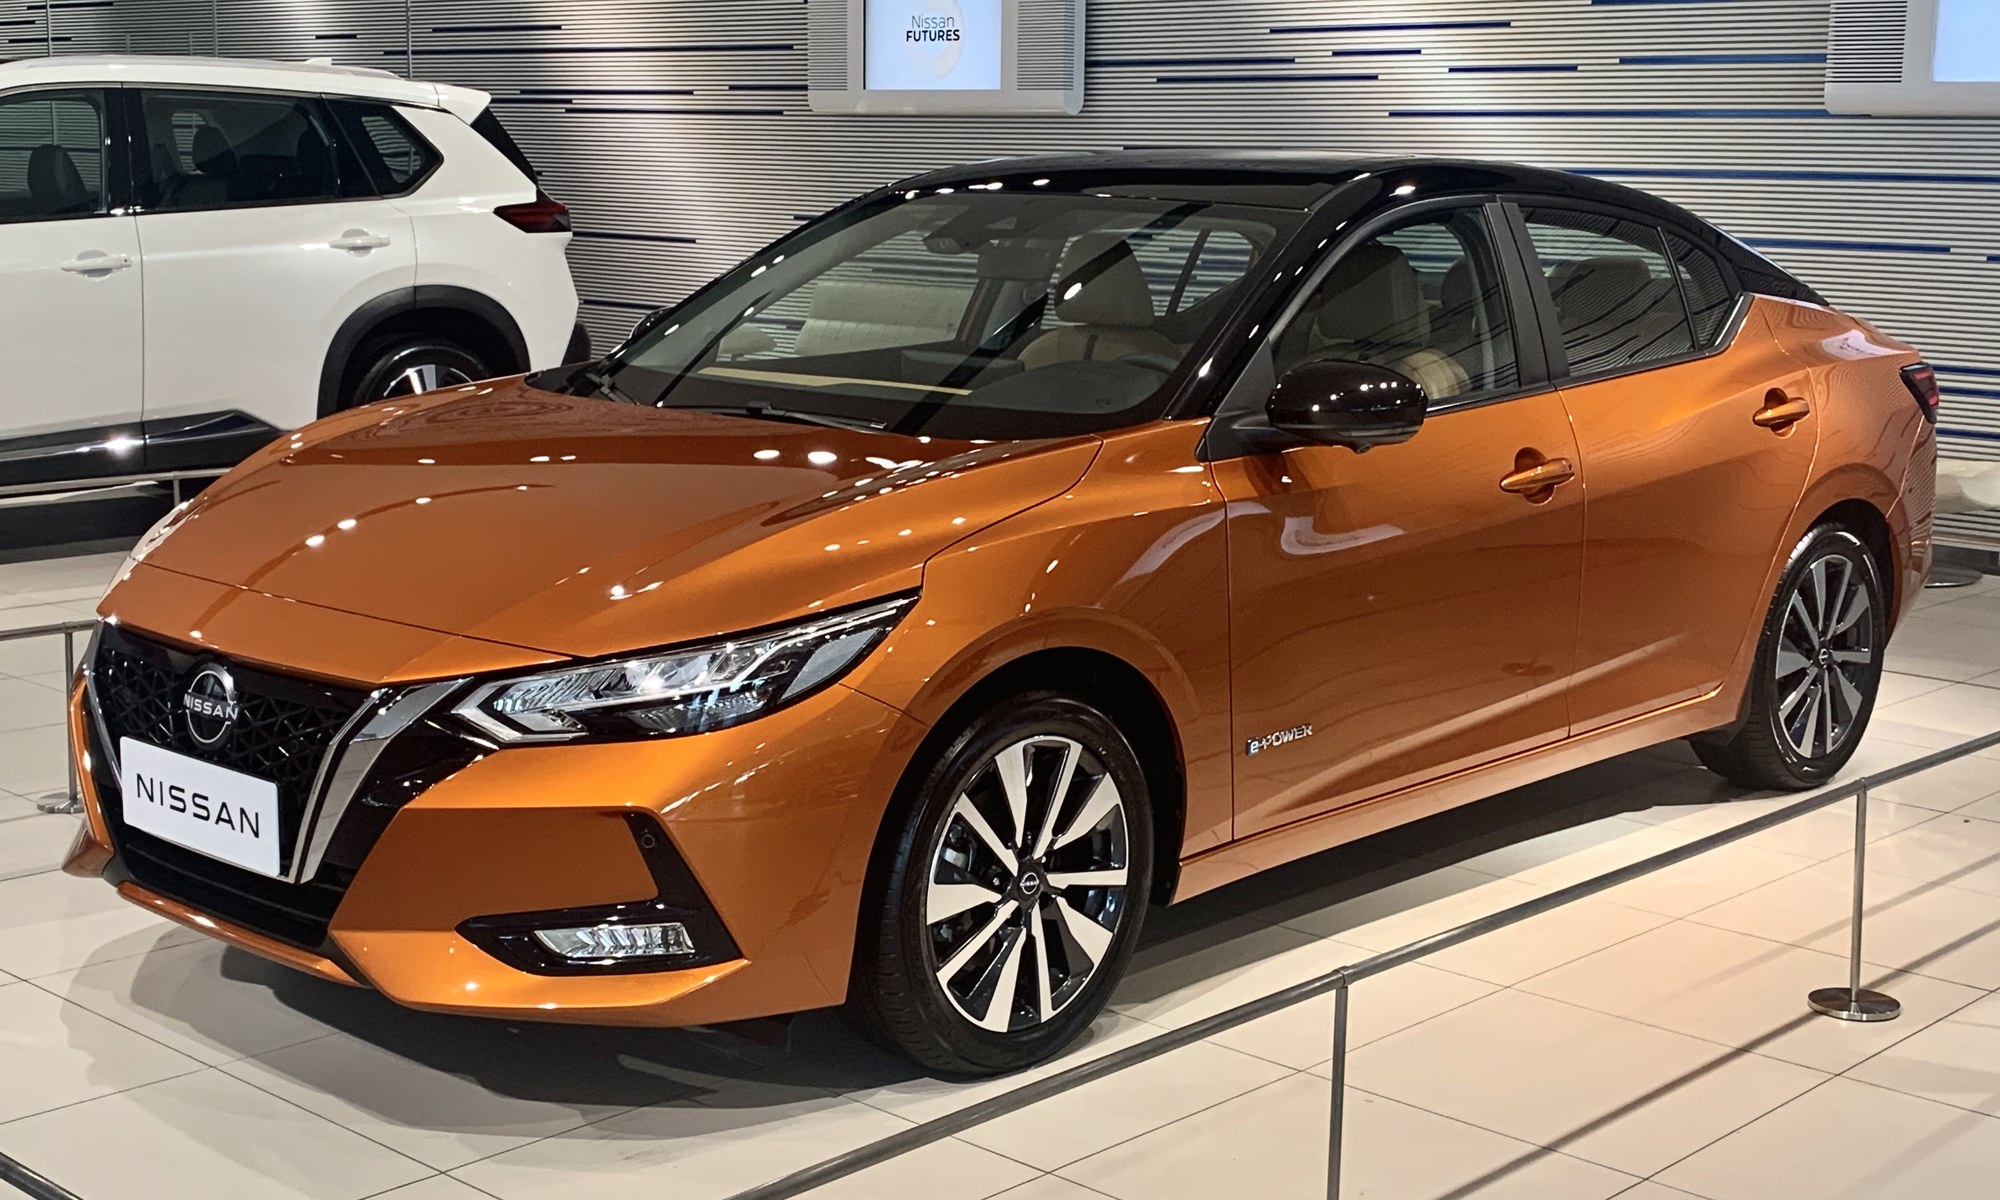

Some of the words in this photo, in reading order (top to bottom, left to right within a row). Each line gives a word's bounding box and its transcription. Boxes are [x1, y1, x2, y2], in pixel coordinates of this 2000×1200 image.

[911, 15, 955, 29] Nissan
[906, 29, 960, 42] FUTURES
[184, 693, 239, 720] NISSAN
[136, 773, 260, 839] NISSAN
